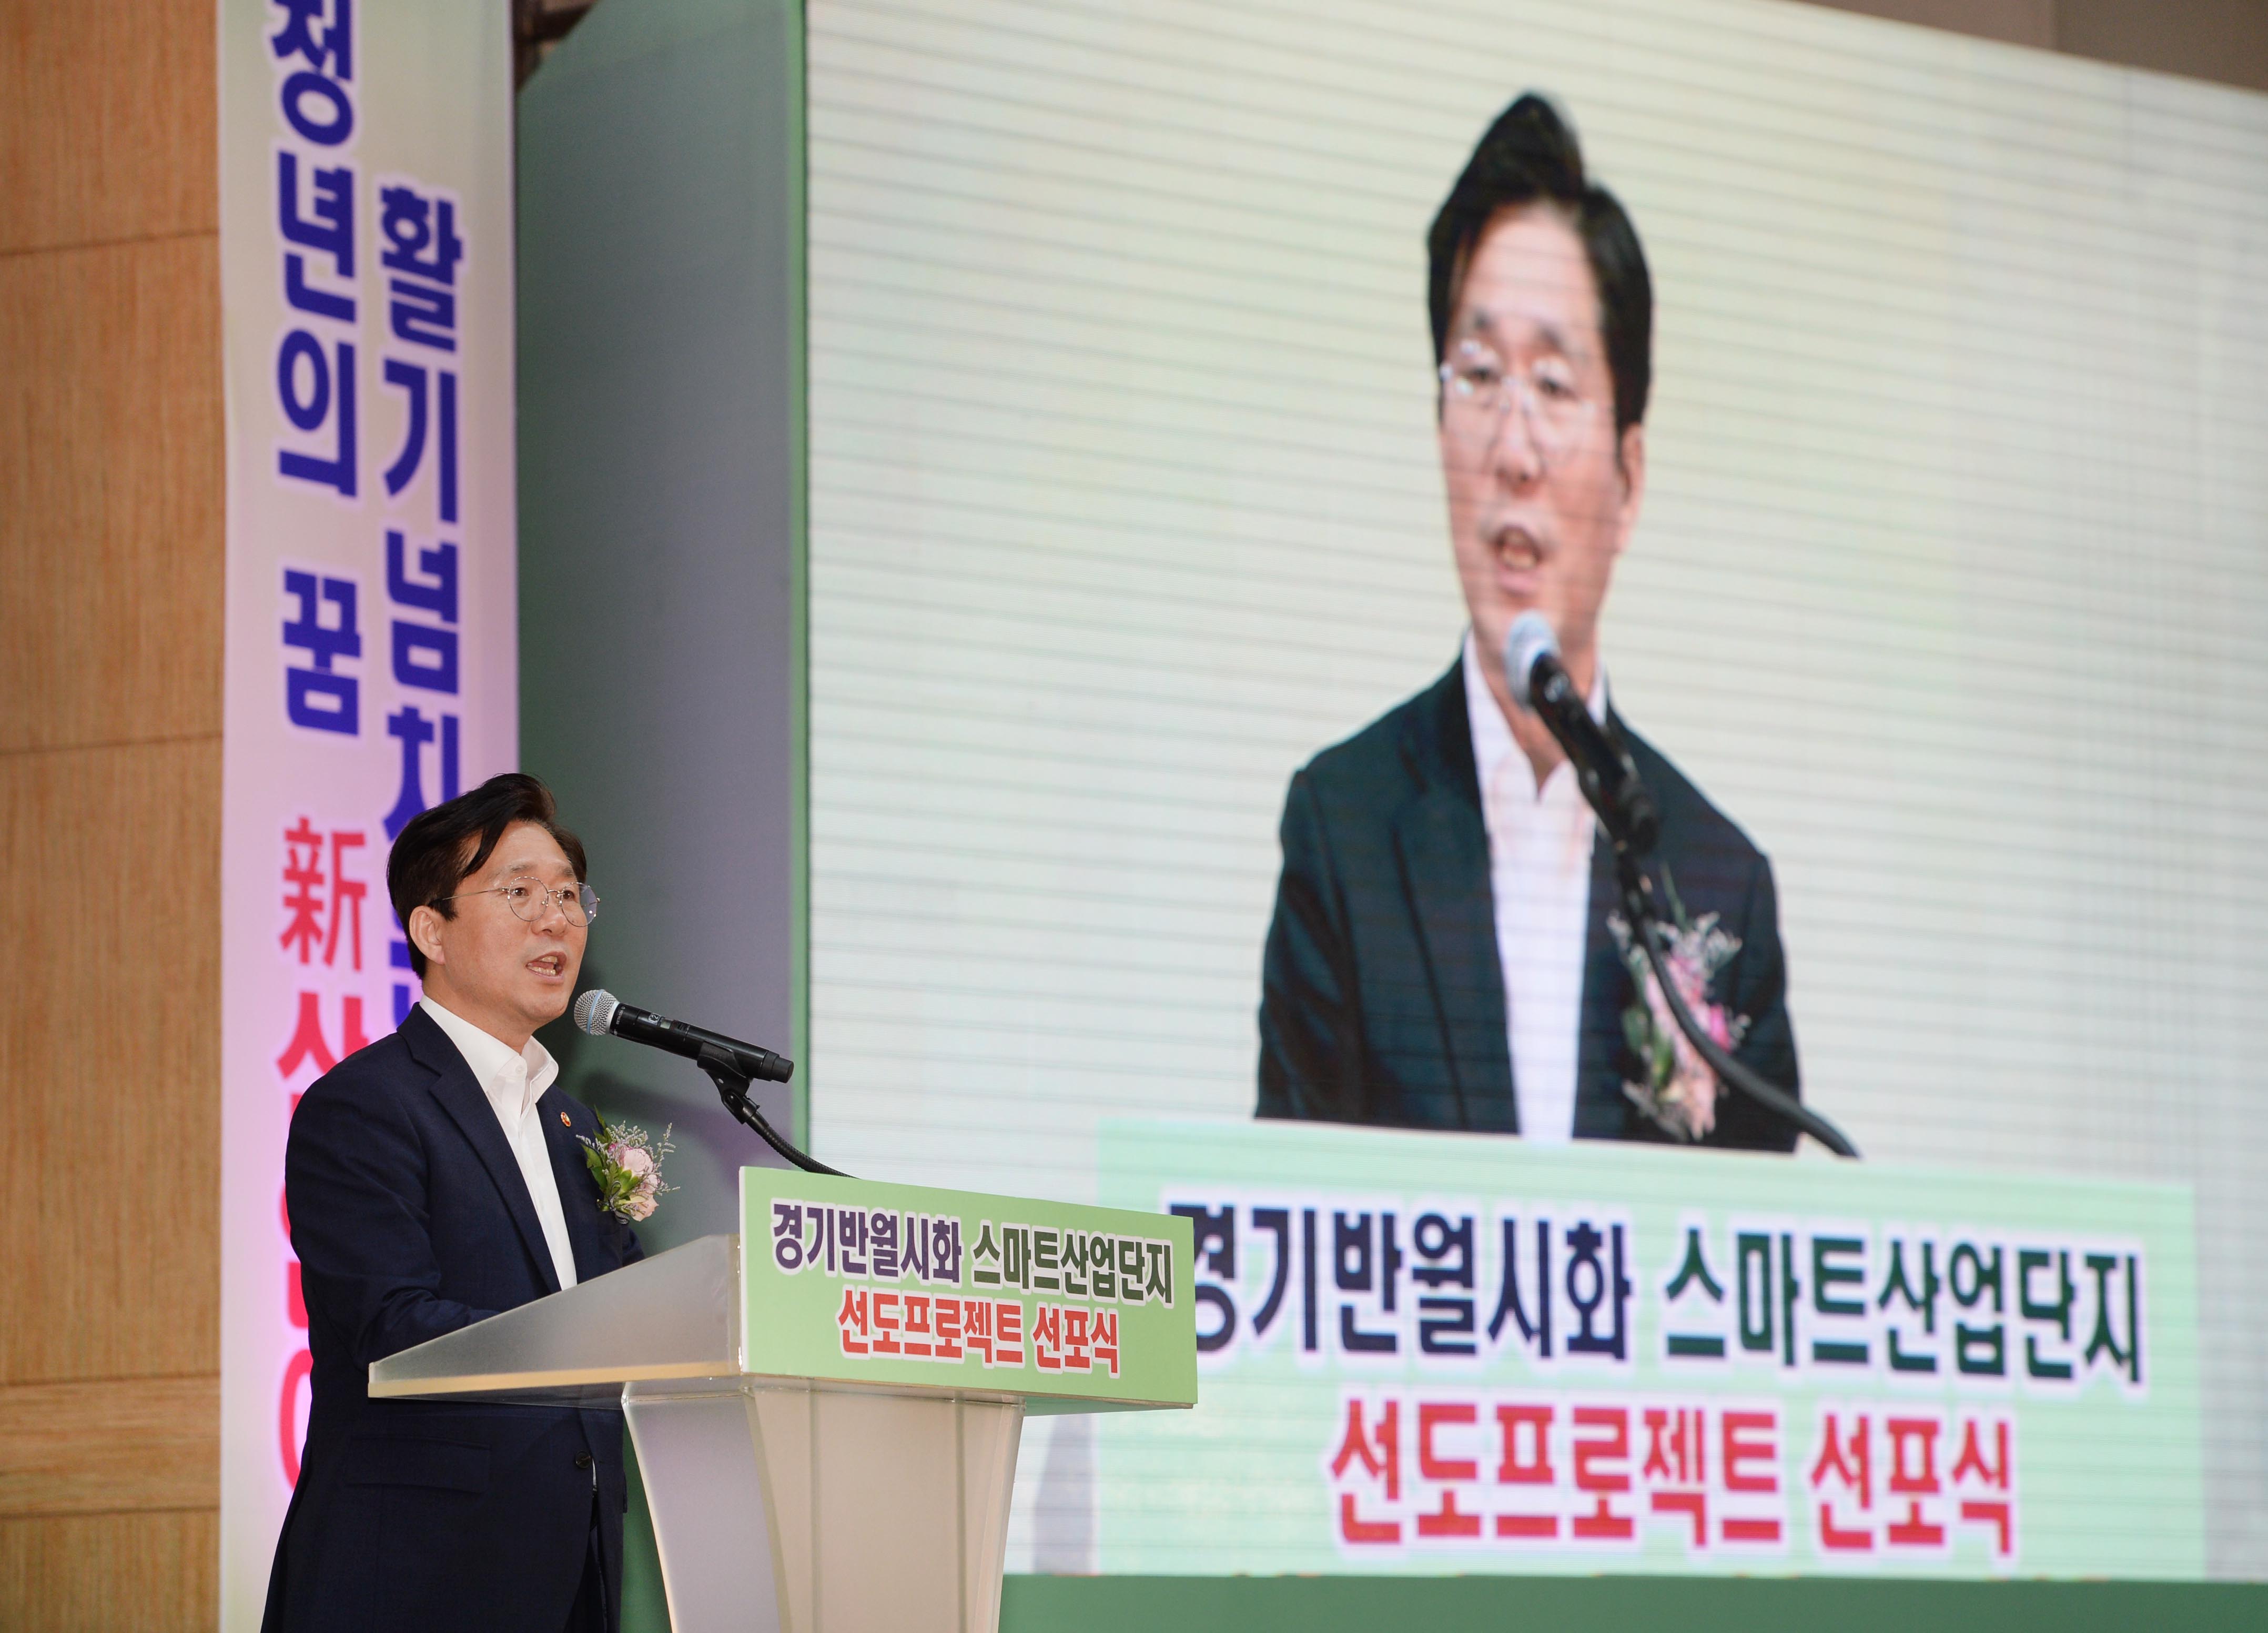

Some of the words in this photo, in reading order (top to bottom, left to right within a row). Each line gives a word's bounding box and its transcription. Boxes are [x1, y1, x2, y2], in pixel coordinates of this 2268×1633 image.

[283, 568, 361, 737] 꿈
[382, 185, 463, 1031] 활기넘치
[773, 1203, 962, 1283] 경기반월시화
[973, 1223, 1172, 1304] 스마트산업단지
[838, 1289, 1023, 1364] 선도프로젝트
[1032, 1306, 1118, 1374] 선포식
[1169, 1203, 1632, 1360] 경기반월시화
[1665, 1228, 2141, 1384] 스마트산업단지
[1331, 1398, 1782, 1548] 선도프로젝트
[1811, 1413, 2011, 1557] 선포식
